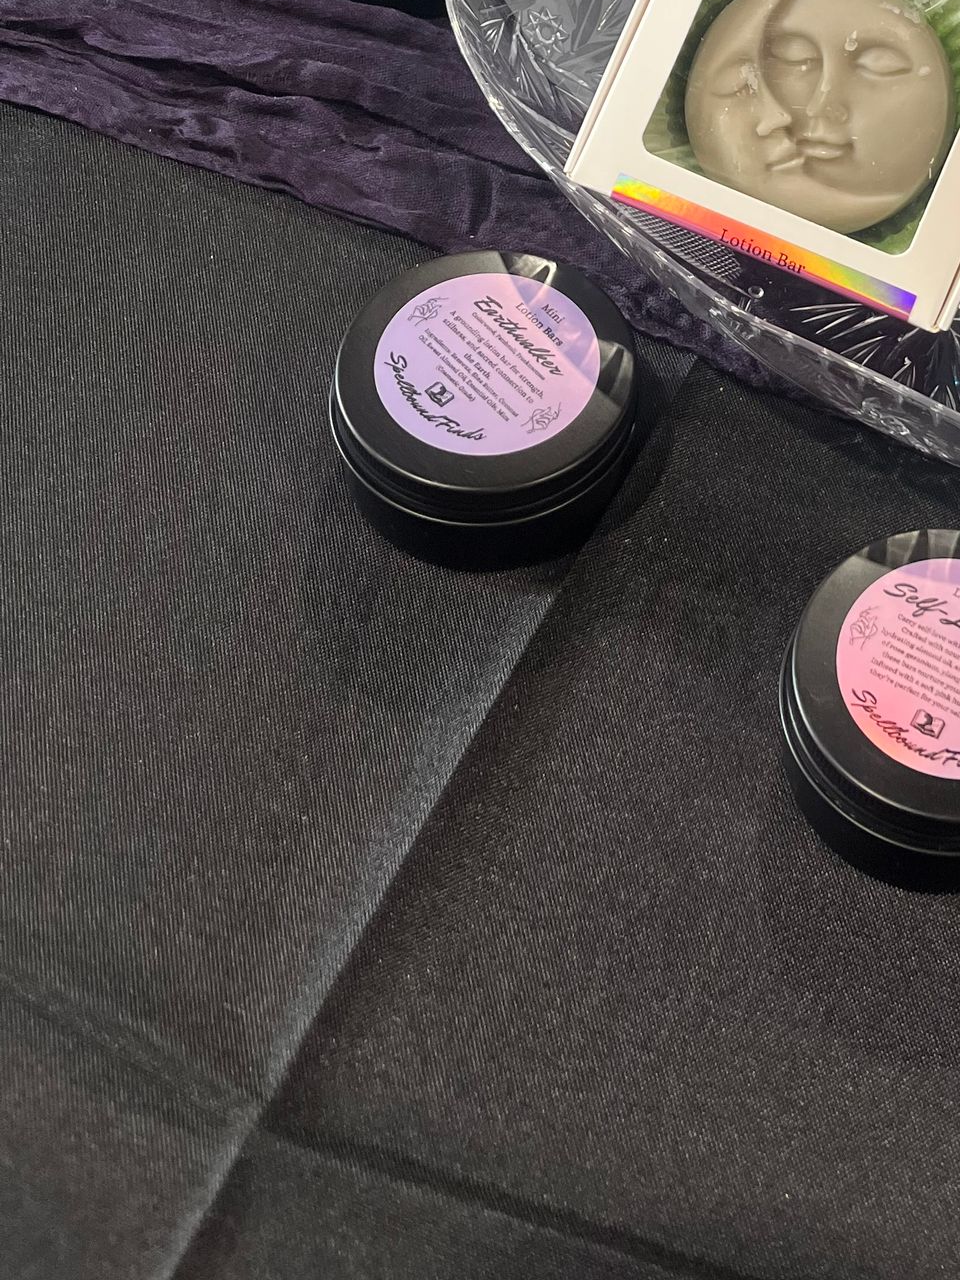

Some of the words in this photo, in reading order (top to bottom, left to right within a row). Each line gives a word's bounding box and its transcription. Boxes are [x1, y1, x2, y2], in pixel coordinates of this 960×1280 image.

[718, 227, 773, 262] Lotion
[776, 251, 806, 274] Bar
[473, 295, 564, 377] Earthwalker
[515, 301, 545, 329] Lotion
[543, 325, 565, 347] Bars
[540, 302, 566, 325] Mini
[462, 351, 476, 364] the
[465, 338, 479, 352] and
[384, 351, 441, 423] Spellbound
[435, 414, 488, 441] Finds
[852, 687, 945, 762] Spellbound
